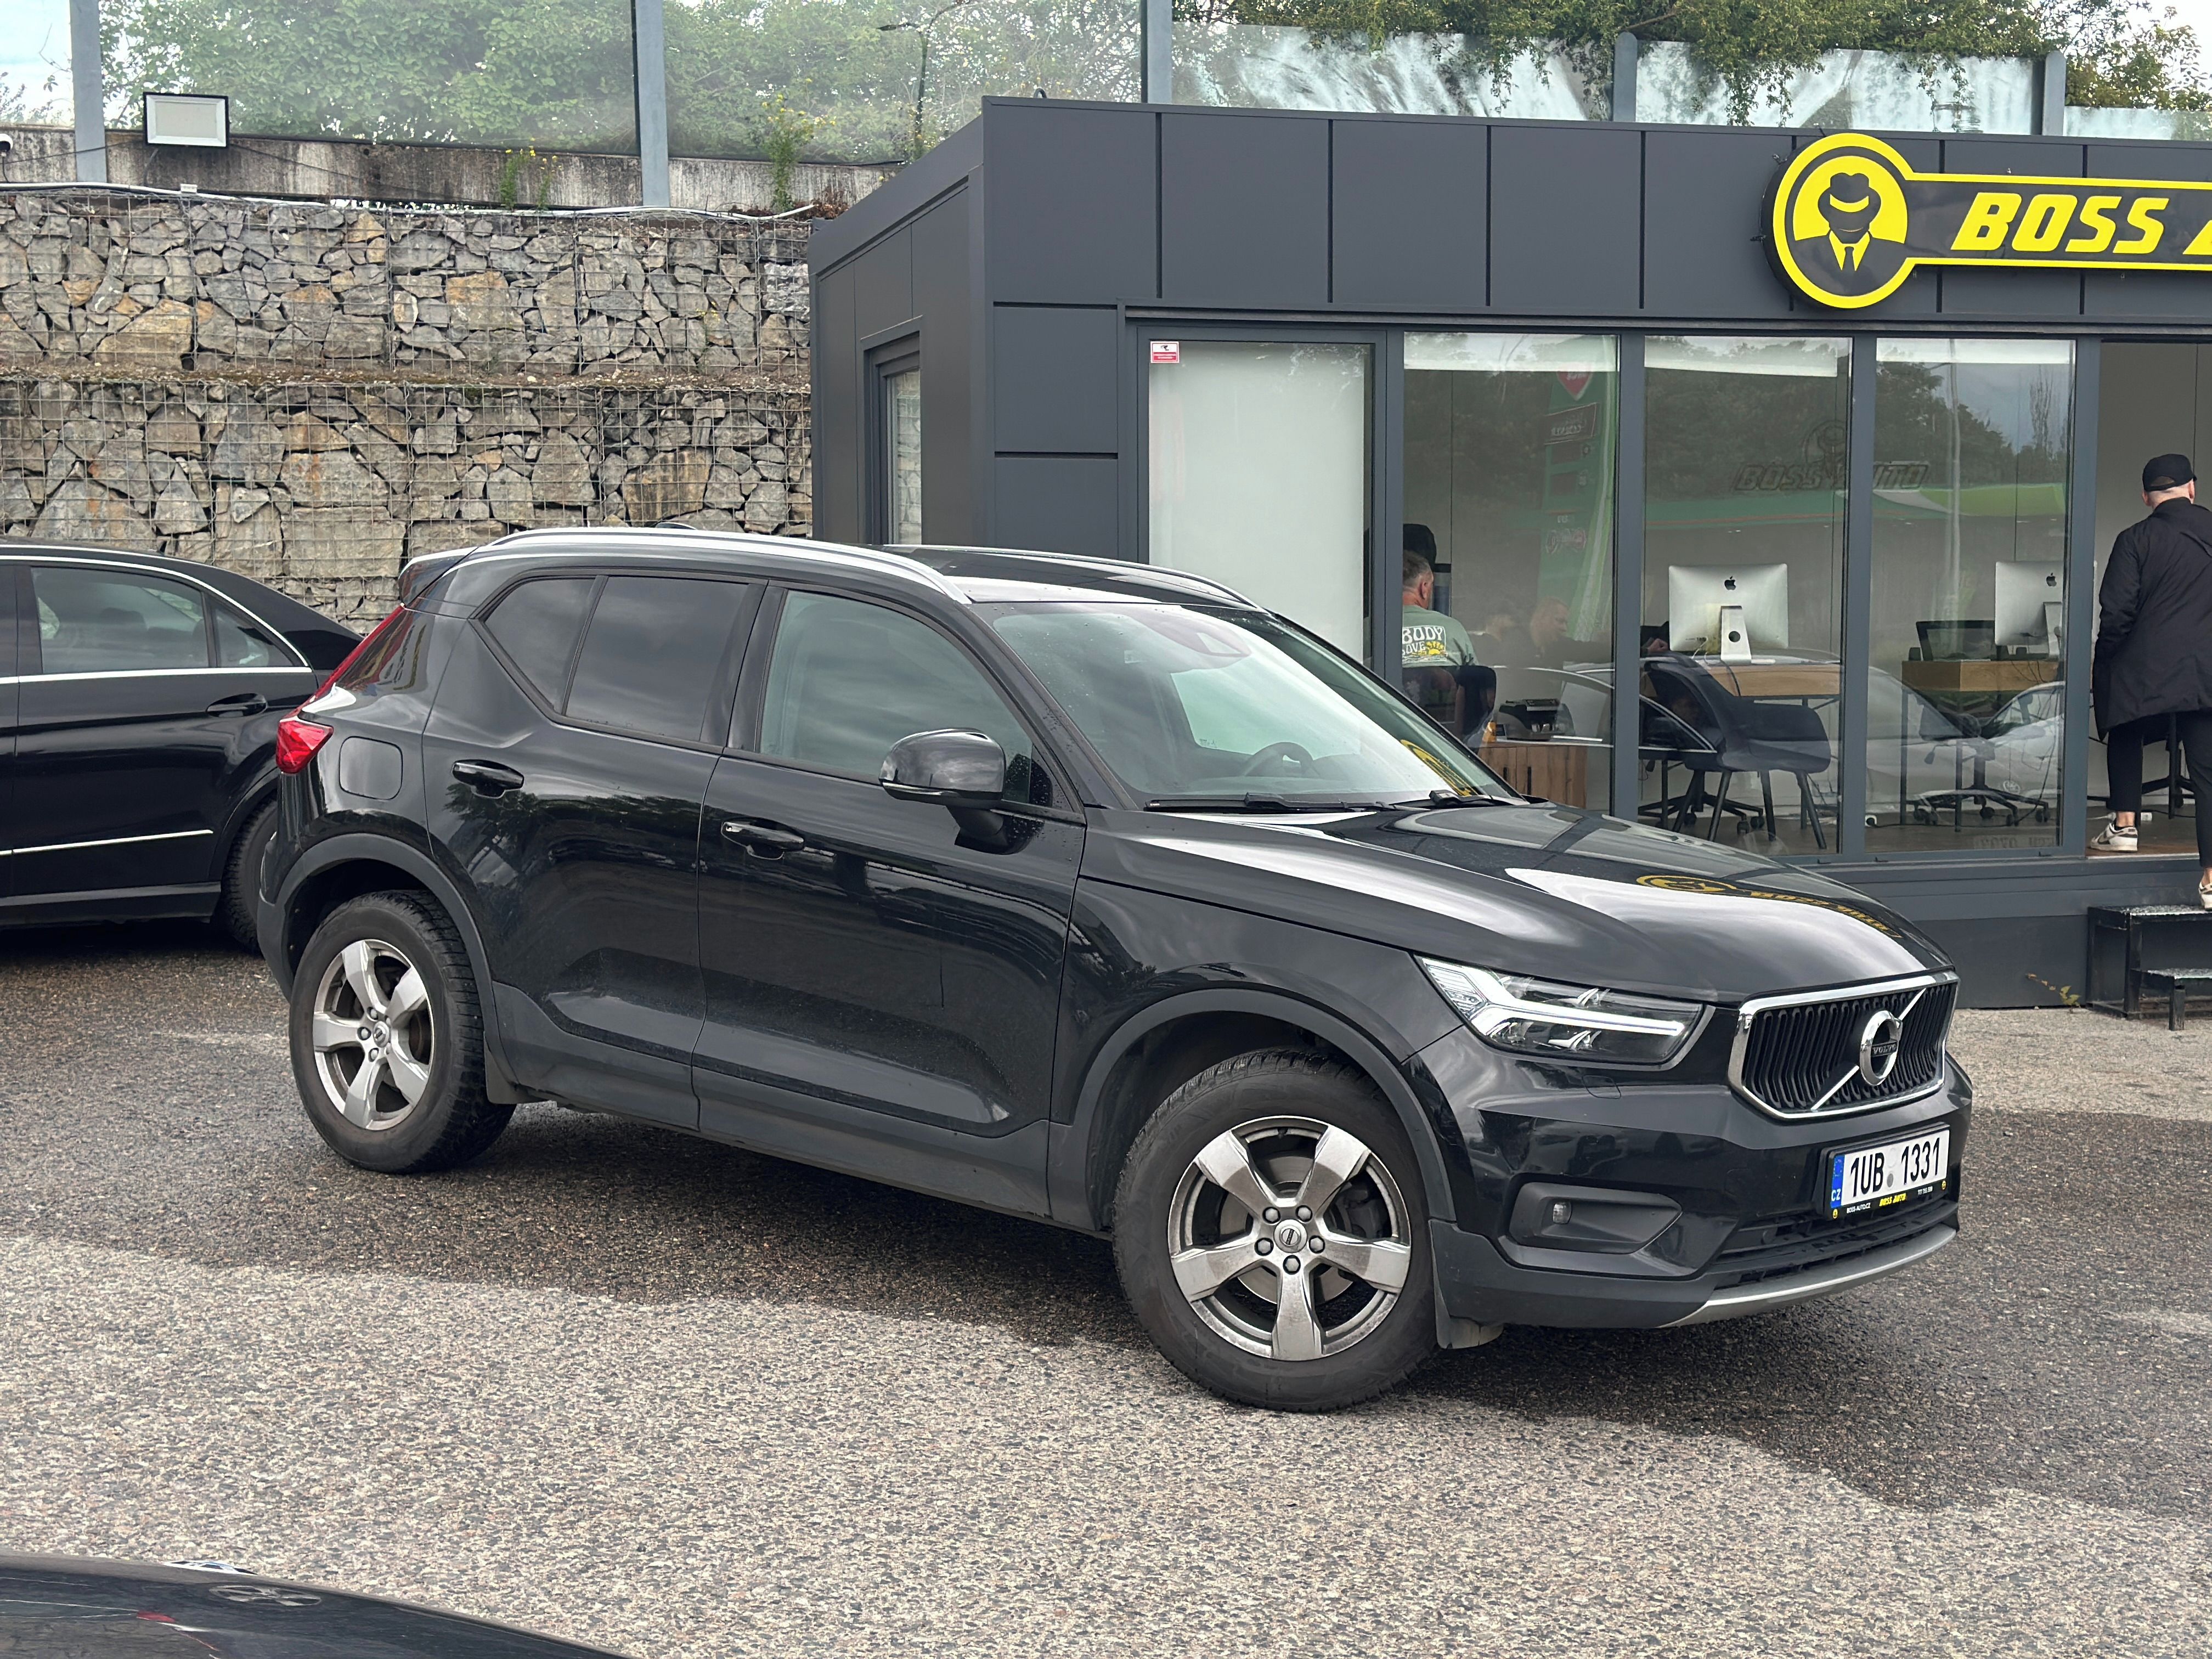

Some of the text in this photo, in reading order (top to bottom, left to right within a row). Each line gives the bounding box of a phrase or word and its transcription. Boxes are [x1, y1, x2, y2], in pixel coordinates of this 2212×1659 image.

[1950, 192, 2170, 255] BOSS
[1734, 464, 1822, 490] BOSS
[1872, 1043, 1897, 1054] VOLVO
[1850, 1137, 1940, 1197] 1UB 1331
[1831, 1189, 1841, 1201] CZ
